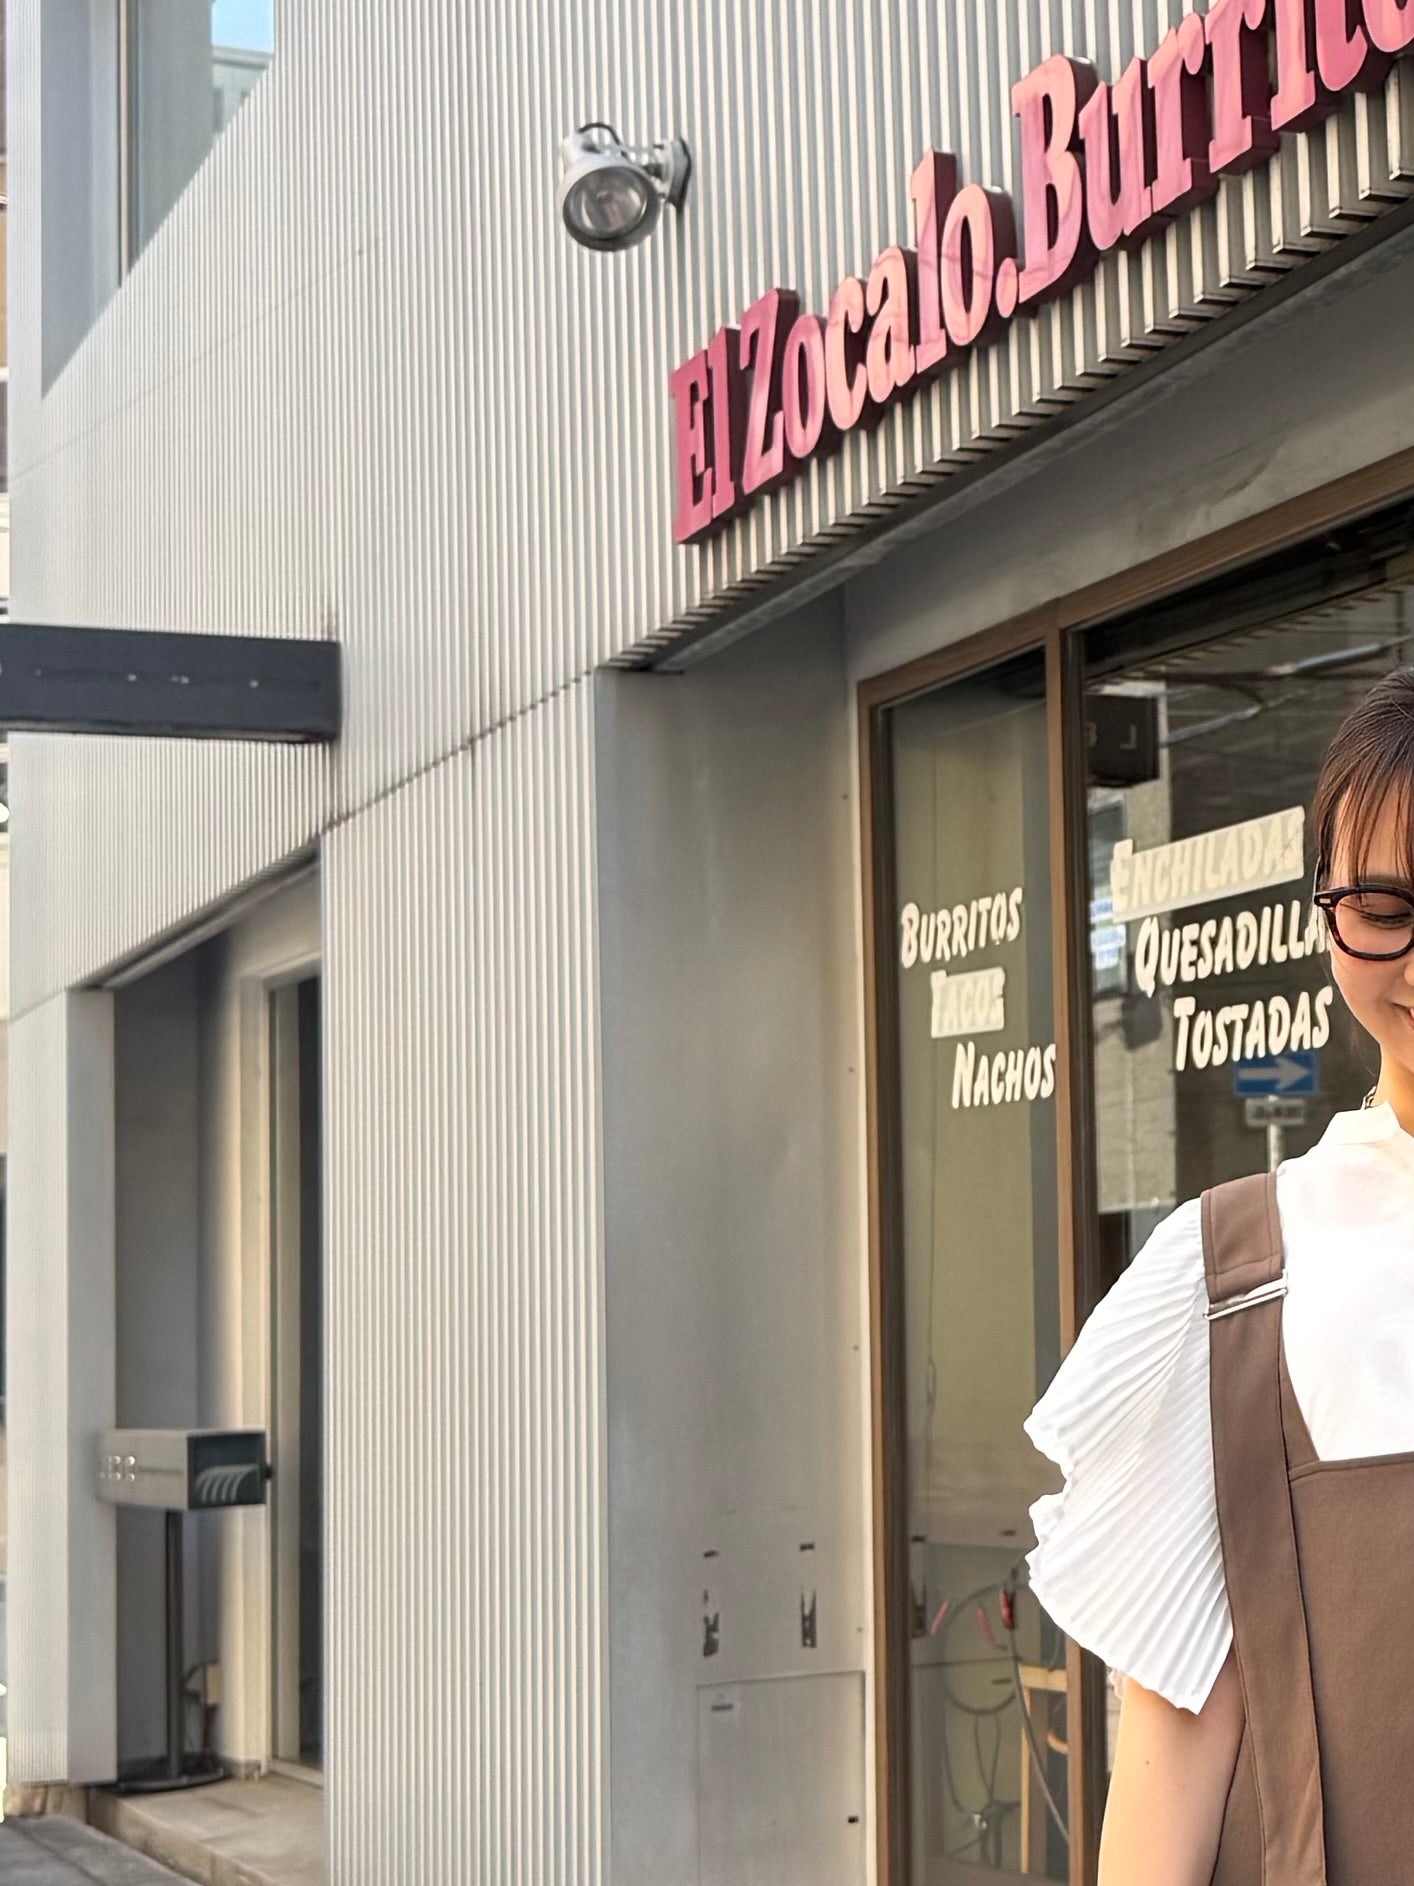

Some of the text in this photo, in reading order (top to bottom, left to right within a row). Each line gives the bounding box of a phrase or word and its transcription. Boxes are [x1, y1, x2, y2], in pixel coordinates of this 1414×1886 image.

[671, 326, 735, 543] El
[901, 887, 1023, 969] BURRITOS
[1135, 900, 1331, 998] QUESADILLA
[1173, 986, 1334, 1071] TOSTADAS
[952, 1041, 1056, 1109] NACHOS
